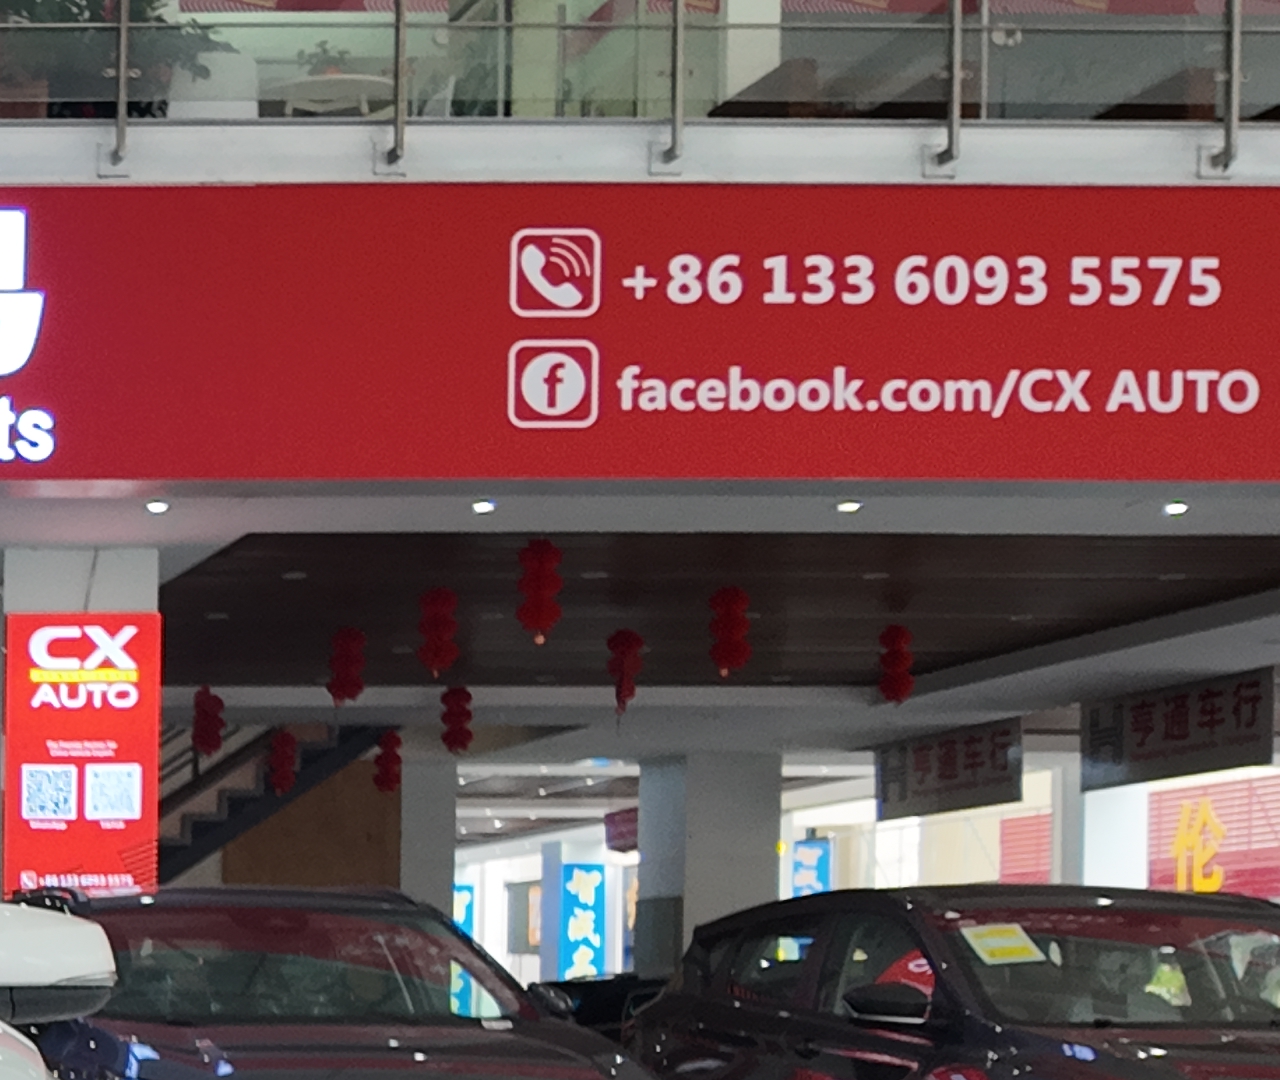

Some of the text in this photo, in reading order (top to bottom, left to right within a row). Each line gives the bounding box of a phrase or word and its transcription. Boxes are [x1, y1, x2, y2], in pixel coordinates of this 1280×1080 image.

[621, 254, 1222, 307] +86 133 6093 5575
[617, 365, 1260, 419] facebook.com/CX AUTO
[28, 625, 139, 670] CX
[30, 683, 140, 709] AUTO
